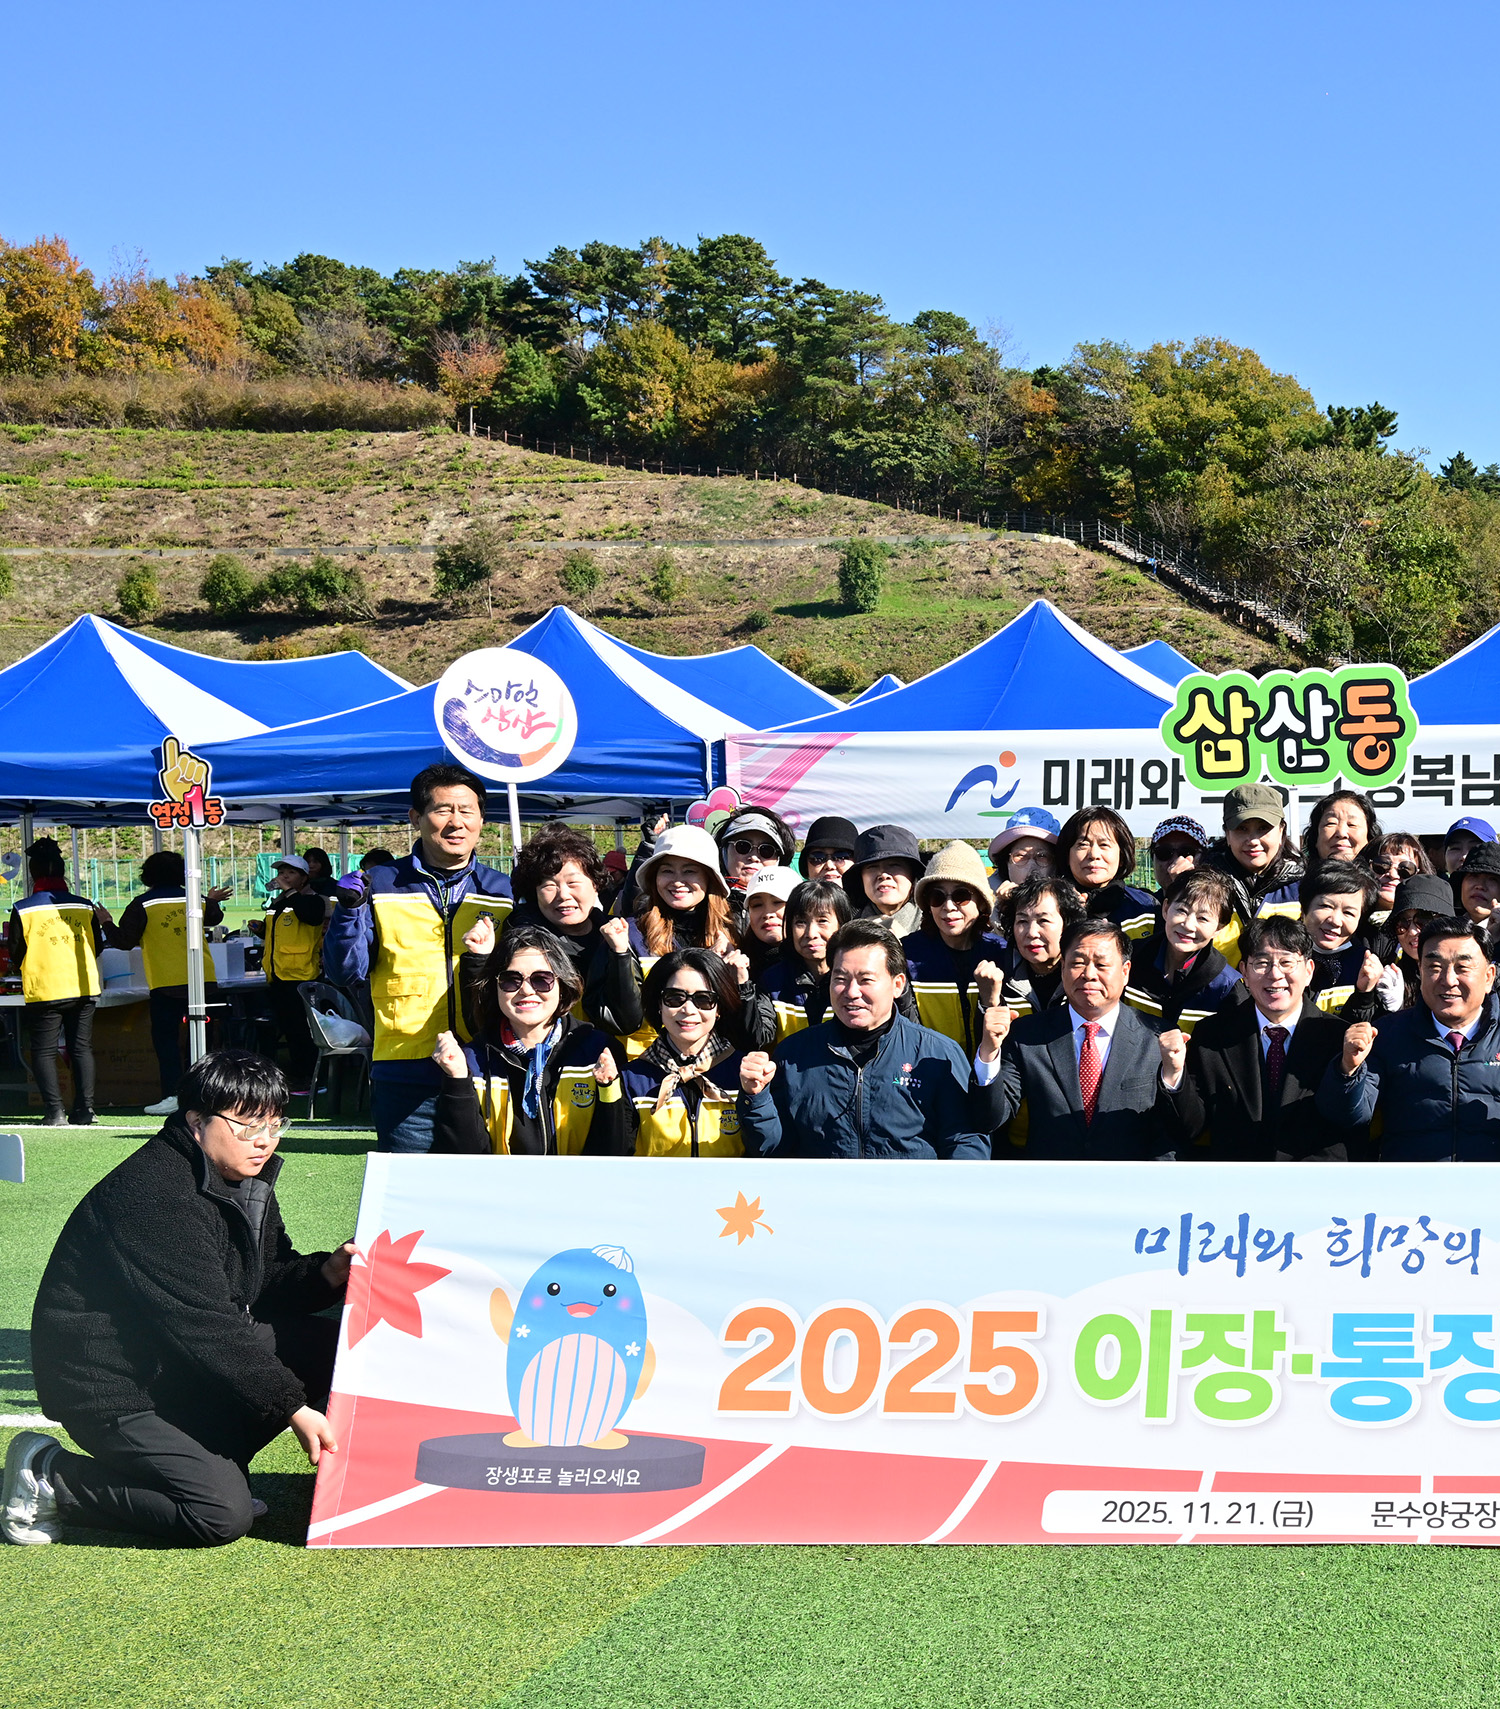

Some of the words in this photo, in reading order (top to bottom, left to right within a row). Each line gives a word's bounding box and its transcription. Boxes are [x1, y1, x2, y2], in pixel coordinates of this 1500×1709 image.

[1174, 678, 1404, 779] 삼산동
[1043, 758, 1185, 809] 미래와
[150, 784, 223, 828] 열정1동
[758, 874, 774, 882] NYC
[1134, 1212, 1303, 1276] 미래와
[1327, 1212, 1482, 1278] 희망의
[717, 1307, 1039, 1416] 2025
[485, 1465, 553, 1488] 장생포로
[557, 1466, 641, 1488] 놀러오세요
[1102, 1500, 1174, 1525] 2025.
[1182, 1501, 1220, 1525] 11.
[1227, 1501, 1265, 1526] 21.
[1271, 1500, 1314, 1529] (금)
[1370, 1501, 1500, 1530] 문수양궁장
